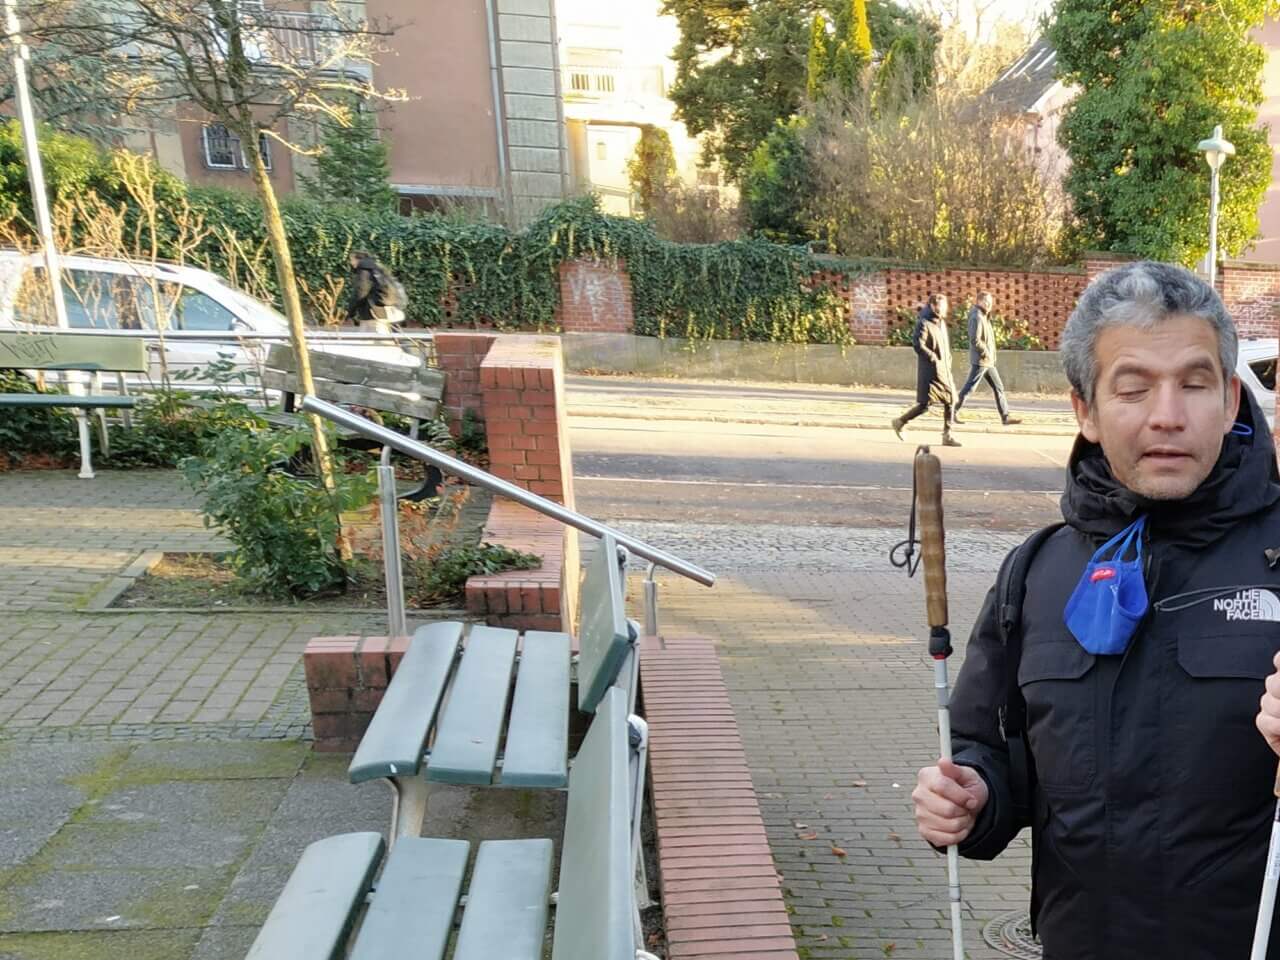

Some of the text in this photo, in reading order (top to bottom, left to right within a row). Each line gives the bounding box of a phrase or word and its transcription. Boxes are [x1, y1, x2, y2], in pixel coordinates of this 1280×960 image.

[1235, 588, 1260, 600] THE
[1213, 598, 1260, 611] NORTH
[1226, 609, 1260, 621] FACE
